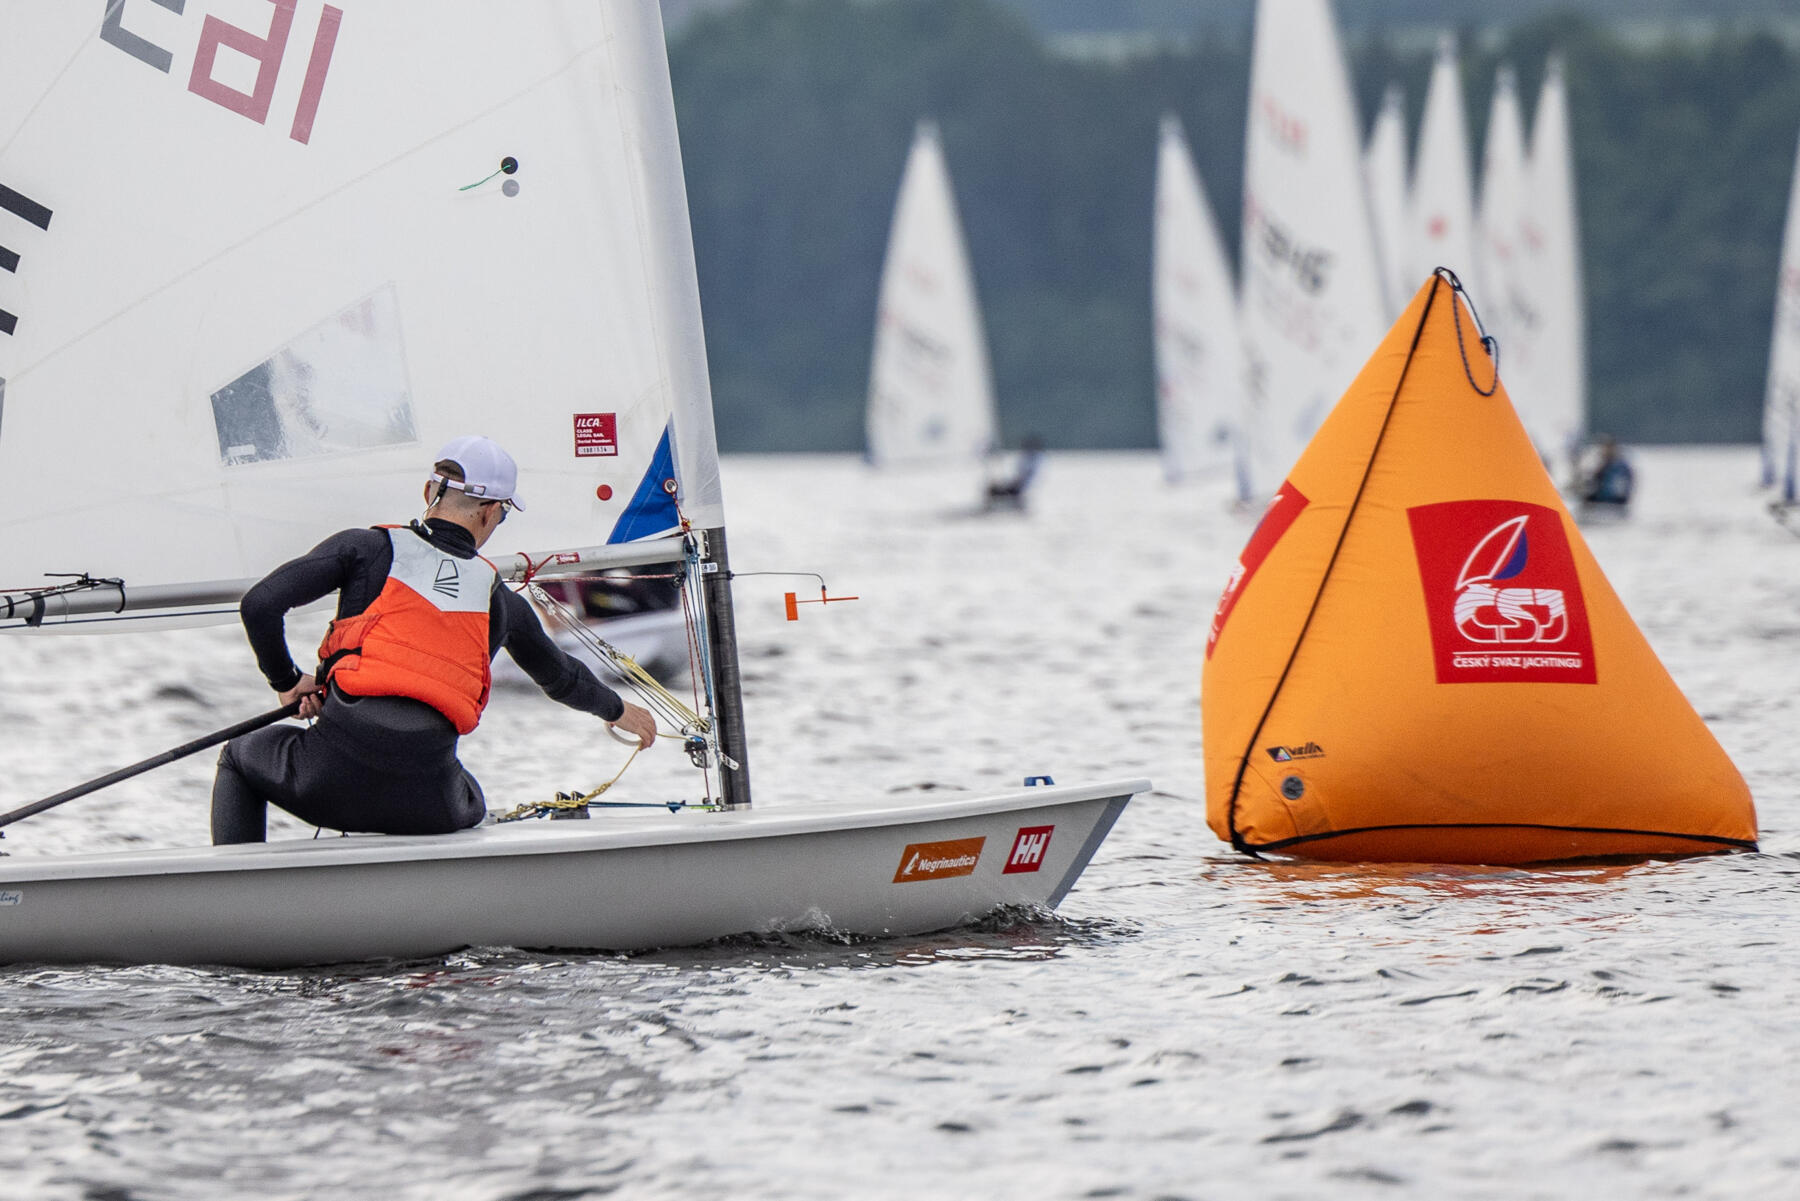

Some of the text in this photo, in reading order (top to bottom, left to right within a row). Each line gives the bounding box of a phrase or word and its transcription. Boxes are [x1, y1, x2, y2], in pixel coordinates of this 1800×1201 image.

[576, 417, 600, 428] ILCA
[1453, 655, 1582, 669] ČESKÝ SVAZ JACHTINGU
[1011, 832, 1047, 865] HH
[918, 854, 976, 873] Negrinautica
